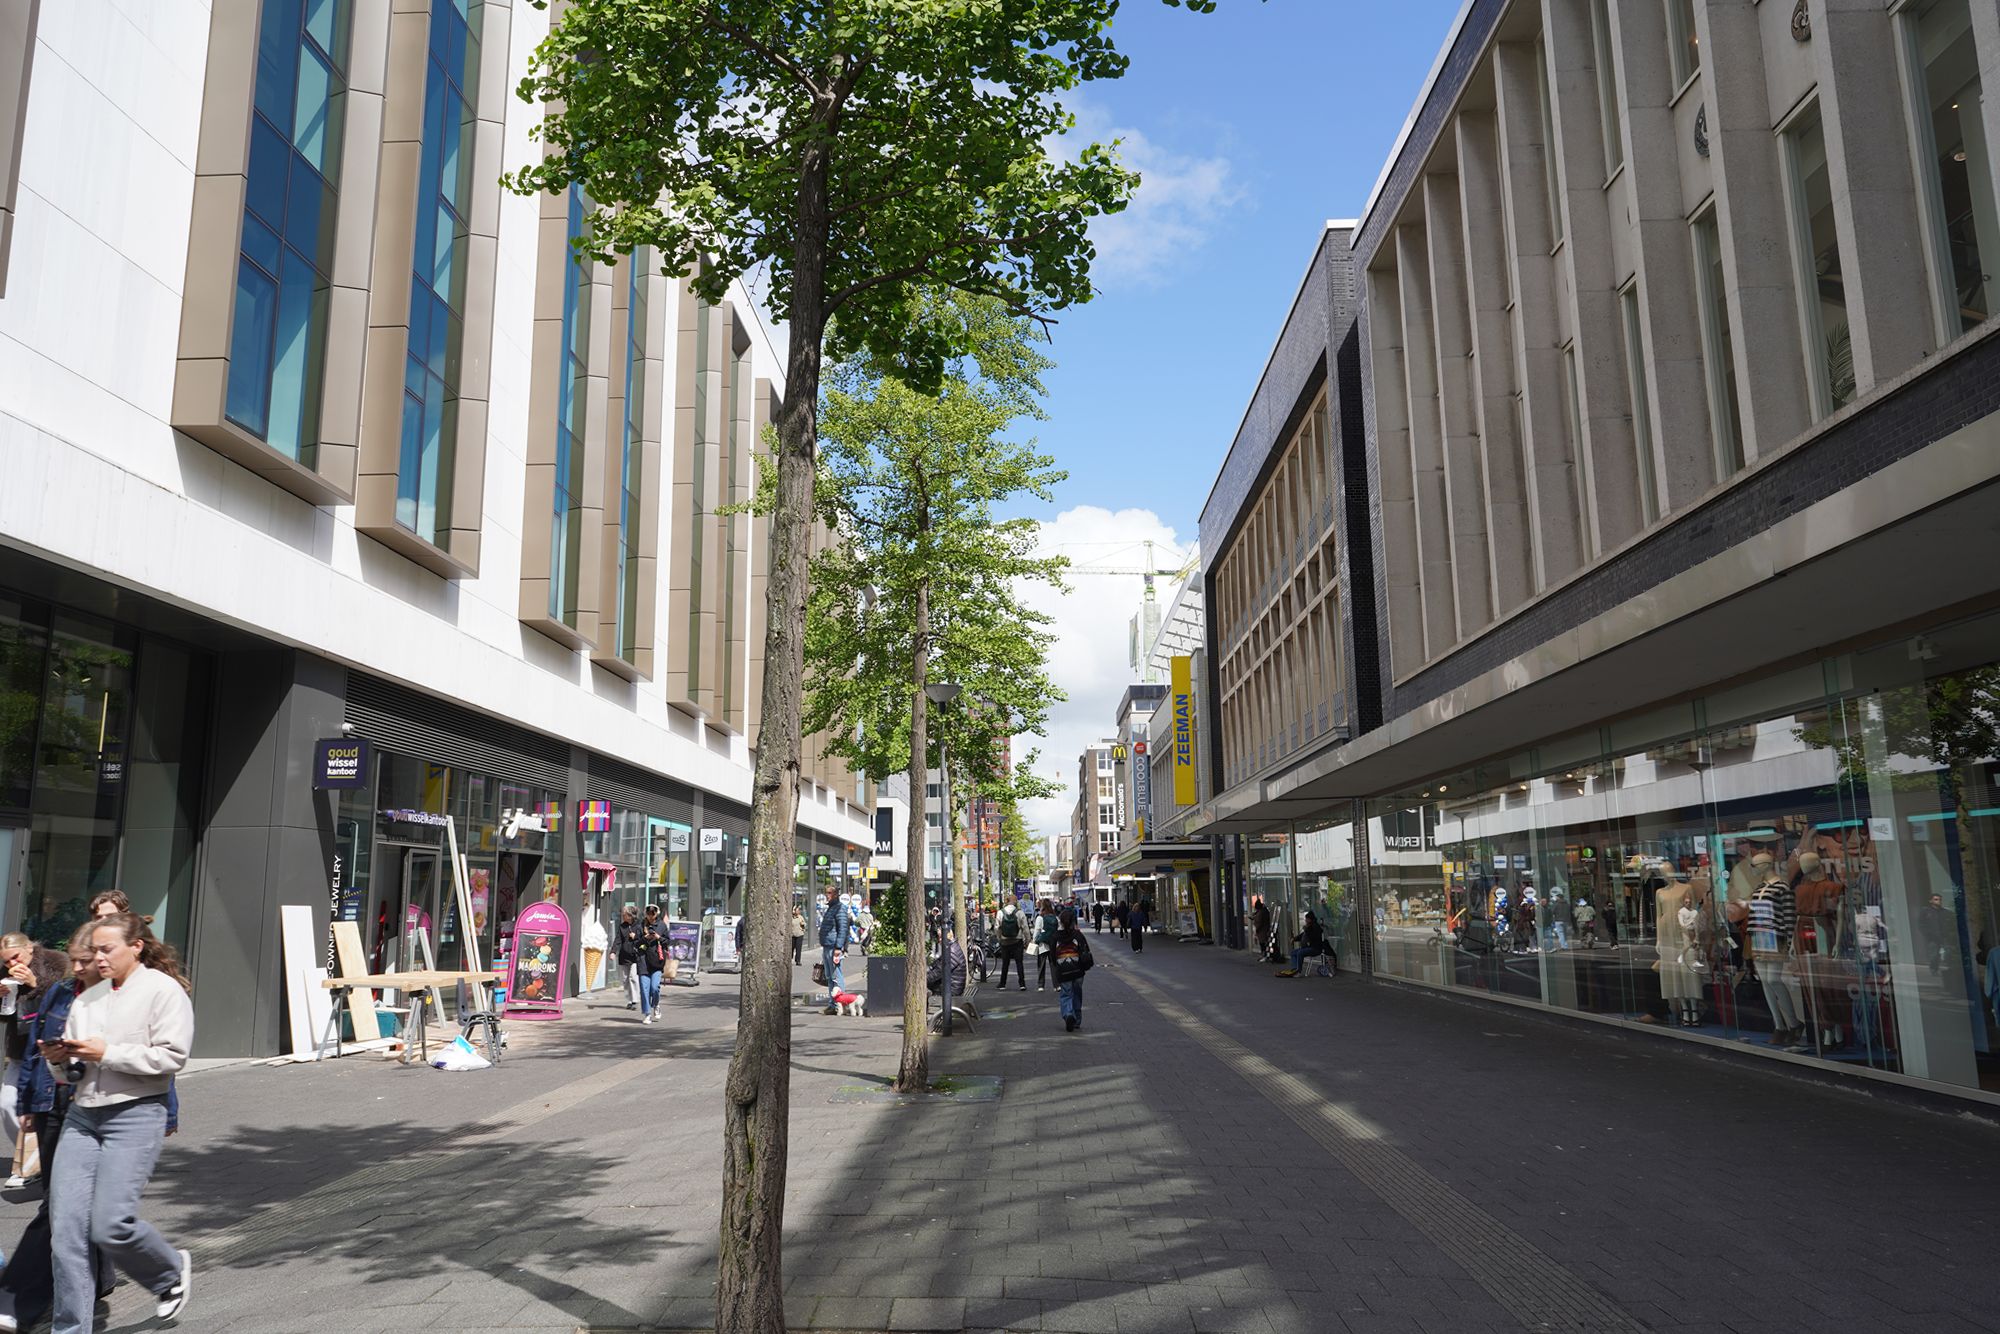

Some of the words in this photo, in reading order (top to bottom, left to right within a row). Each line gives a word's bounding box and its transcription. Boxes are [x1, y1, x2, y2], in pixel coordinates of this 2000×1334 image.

[1176, 694, 1190, 766] ZEEMAN
[327, 758, 358, 767] wissel
[328, 746, 358, 759] goud
[327, 767, 357, 775] kantoor
[1136, 756, 1147, 811] COOLBLUE
[1117, 783, 1125, 827] McDonald's
[330, 855, 342, 917] JEWELRY
[518, 960, 557, 974] MACARONS
